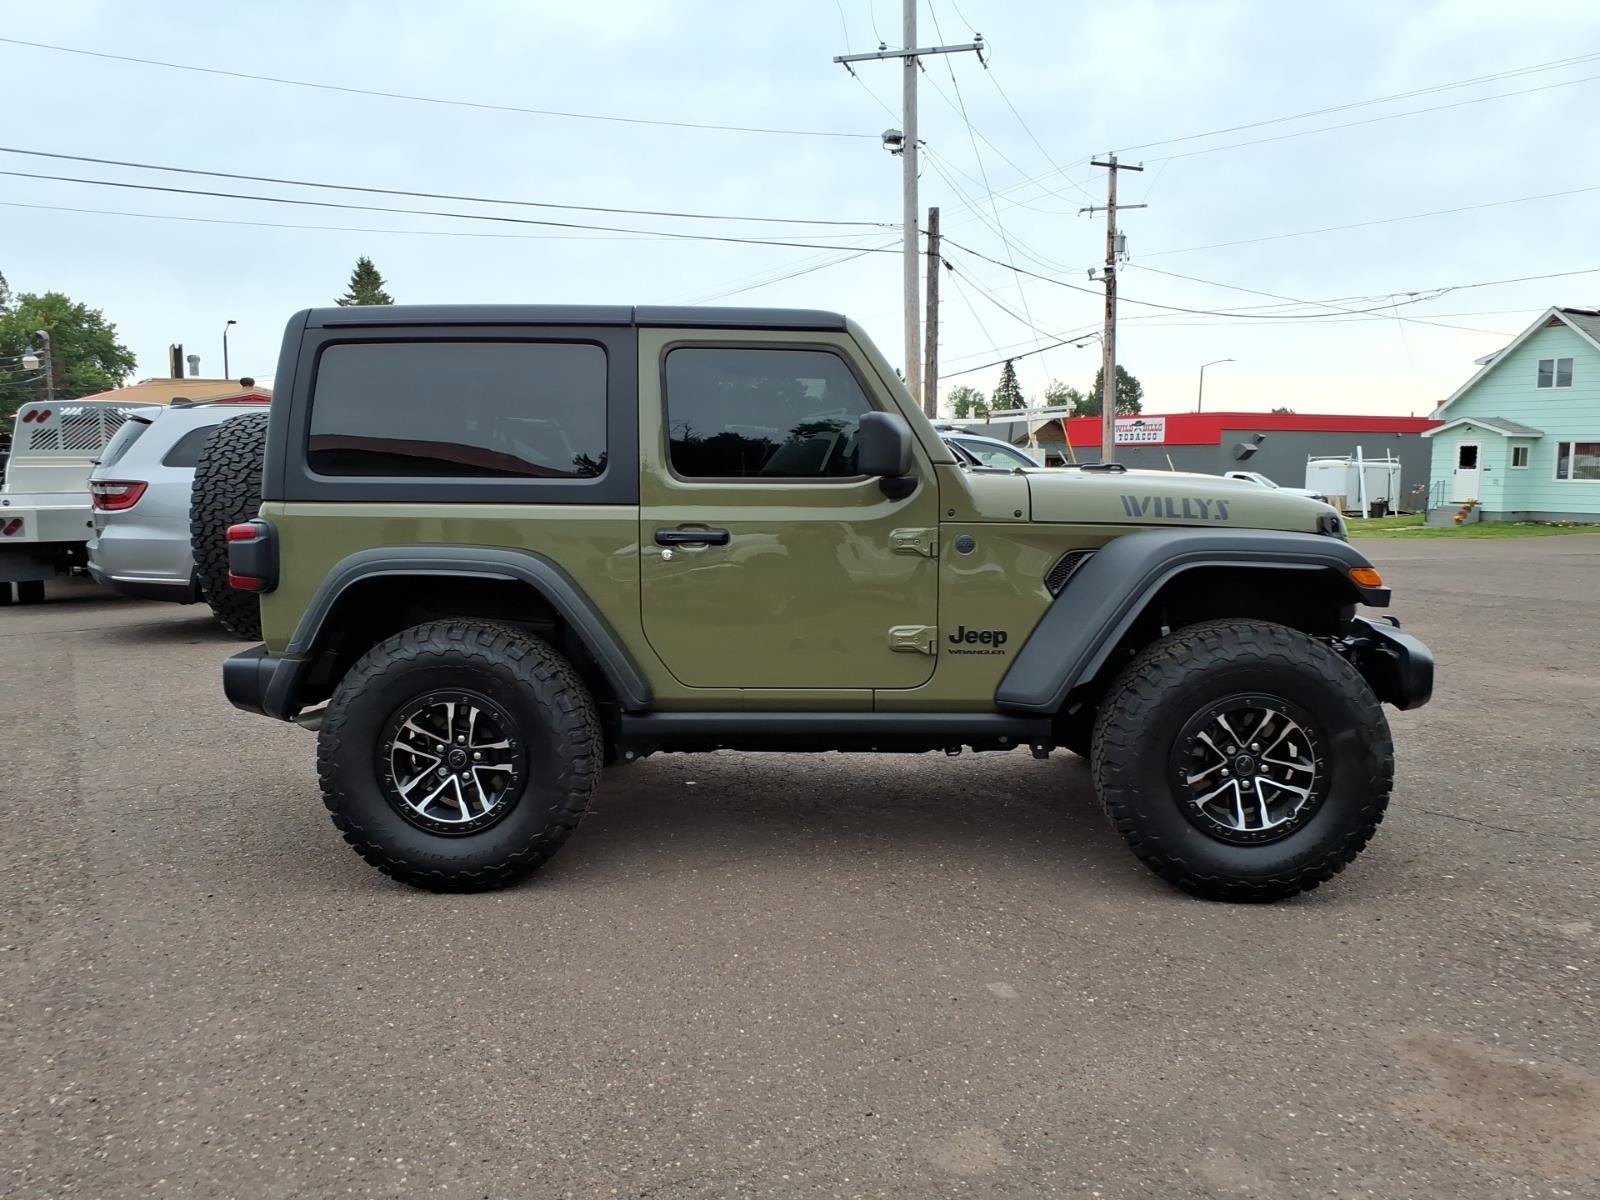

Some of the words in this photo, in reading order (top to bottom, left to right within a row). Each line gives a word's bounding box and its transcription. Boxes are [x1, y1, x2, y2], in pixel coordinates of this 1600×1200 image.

[1115, 424, 1134, 433] WILD
[1118, 432, 1158, 441] TOBACCO
[1119, 495, 1230, 520] WILLYS
[948, 625, 1008, 648] Jeep
